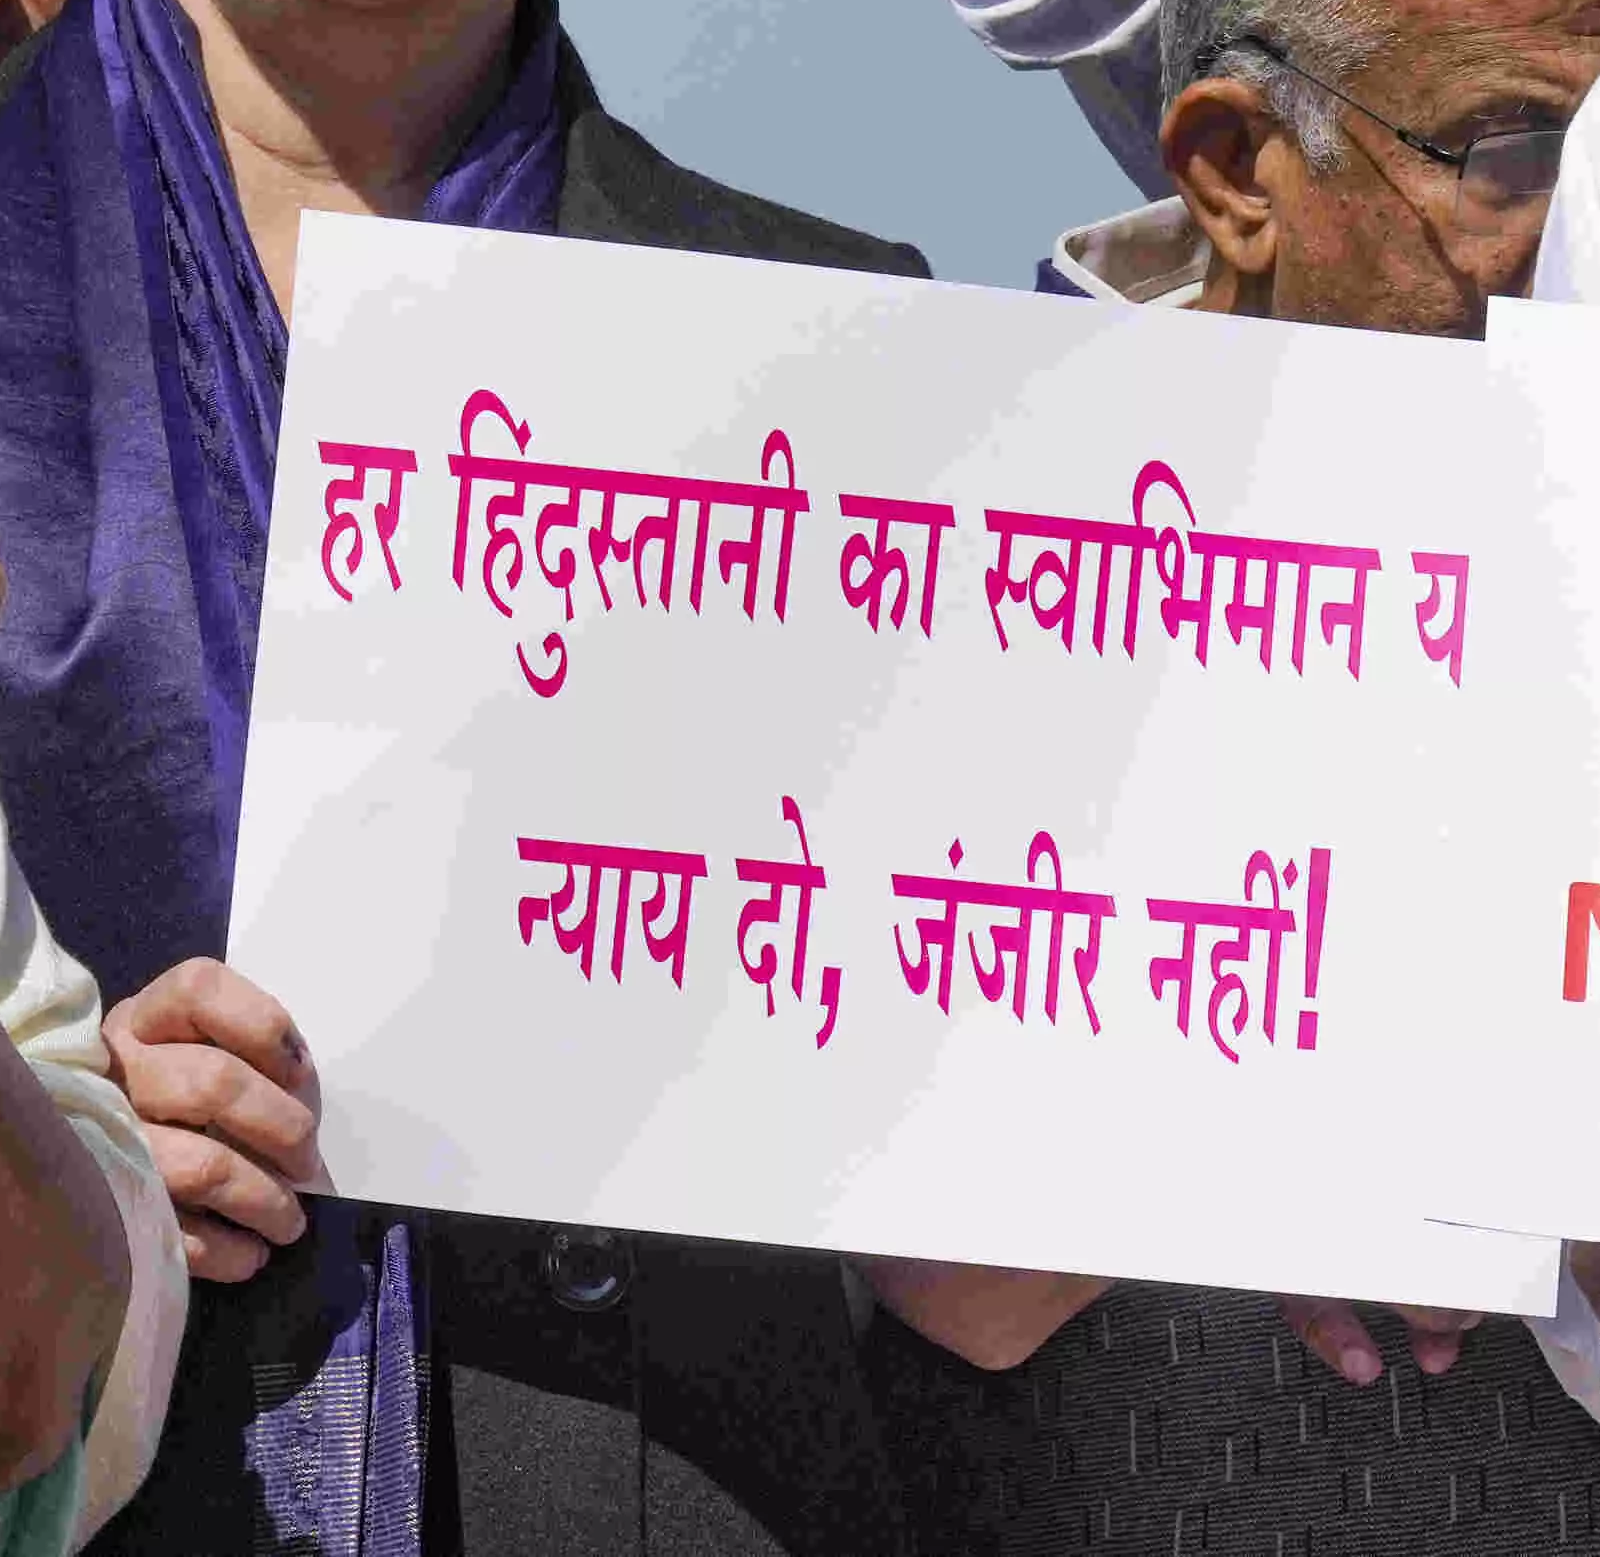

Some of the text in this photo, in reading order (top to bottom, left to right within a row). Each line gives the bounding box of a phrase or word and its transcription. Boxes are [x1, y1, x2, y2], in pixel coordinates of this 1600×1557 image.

[318, 440, 418, 602] हर
[447, 389, 810, 698] हिंदुस्तानी
[839, 493, 957, 638] का
[984, 460, 1382, 680] स्वाभिमान
[517, 795, 1331, 1064] न्याय दो, जंजीर नहीं!
